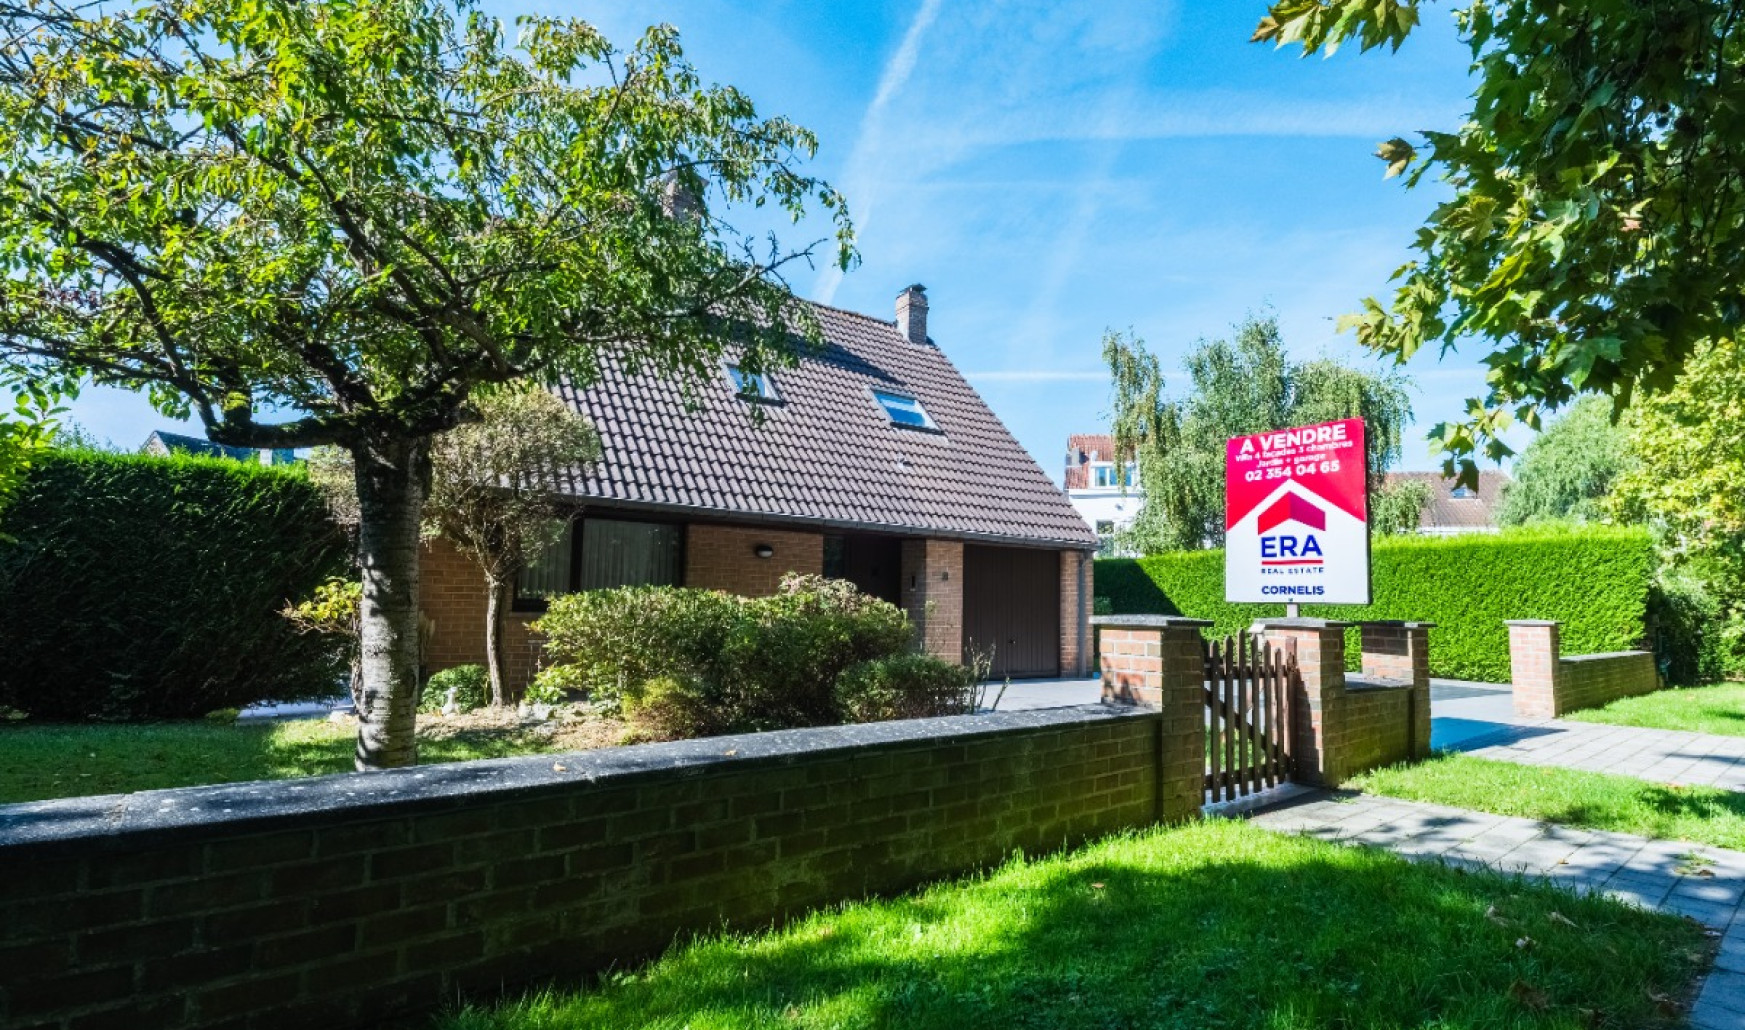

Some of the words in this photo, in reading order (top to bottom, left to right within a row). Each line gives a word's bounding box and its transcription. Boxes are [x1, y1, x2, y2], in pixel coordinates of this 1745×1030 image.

[1240, 438, 1255, 454] A
[1260, 423, 1347, 451] VENDRE
[1298, 445, 1304, 453] 3
[1306, 440, 1354, 452] chambres
[1294, 453, 1327, 465] garage
[1245, 470, 1263, 482] 02
[1266, 466, 1292, 479] 354
[1296, 463, 1317, 476] 04
[1320, 460, 1341, 473] 65
[1261, 534, 1324, 558] ERA
[1288, 566, 1325, 575] ESTATE
[1261, 585, 1326, 596] CORNELIS
